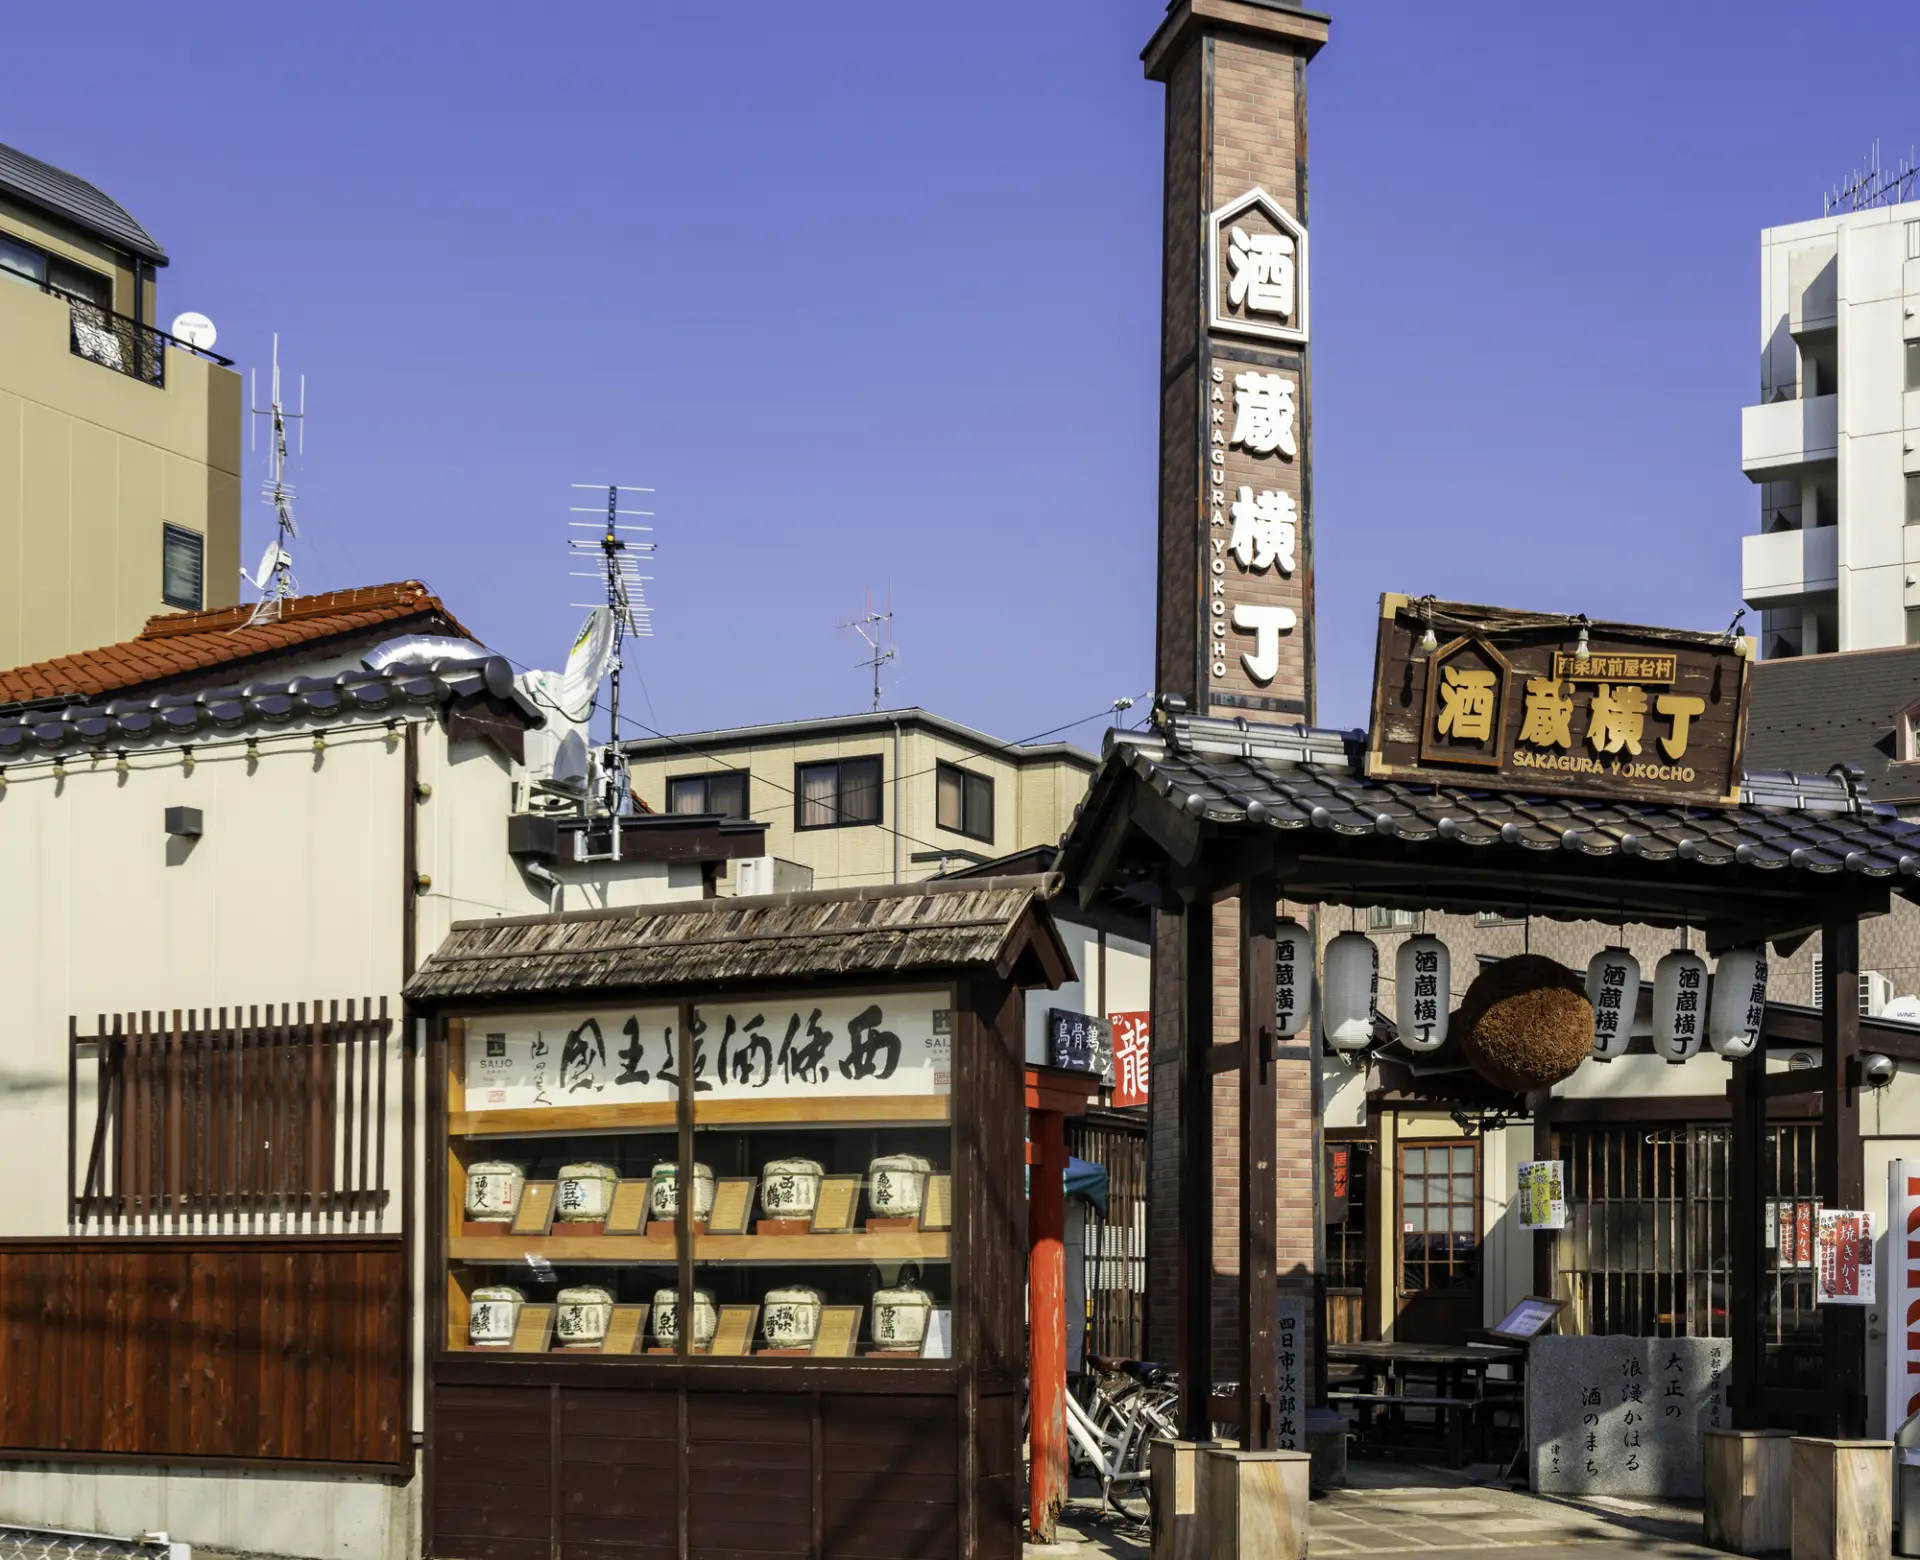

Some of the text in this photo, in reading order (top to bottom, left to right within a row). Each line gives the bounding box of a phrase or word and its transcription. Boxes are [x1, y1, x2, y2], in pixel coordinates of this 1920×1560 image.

[1228, 226, 1297, 681] 酒蔵横丁
[1211, 367, 1226, 678] SAKAGURA YOKOCHO
[1558, 657, 1672, 678] 西条駅前屋台村
[1438, 665, 1706, 760] 酒蔵横丁
[1512, 751, 1695, 783] SAKAGURA YOKOCHO
[1112, 1014, 1124, 1026] ロン
[1276, 939, 1295, 1031] 酒蔵横丁
[1414, 950, 1438, 1043] 酒蔵横丁
[1593, 963, 1627, 1052] 酒蔵横丁
[1671, 966, 1700, 1055] 酒蔵横丁
[1741, 960, 1767, 1048] 酒蔵横丁
[480, 1059, 512, 1068] SAIJO
[1058, 1050, 1112, 1075] ラーメン
[1116, 1018, 1149, 1099] 龍
[473, 1176, 490, 1208] 福美人
[563, 1179, 581, 1210] 白牡丹
[1840, 1224, 1857, 1294] 焼きがき
[658, 1312, 675, 1336] 泉
[1622, 1357, 1643, 1472] 浪漫かほる
[1664, 1352, 1685, 1419] 大正の
[1581, 1387, 1601, 1477] 酒のまち
